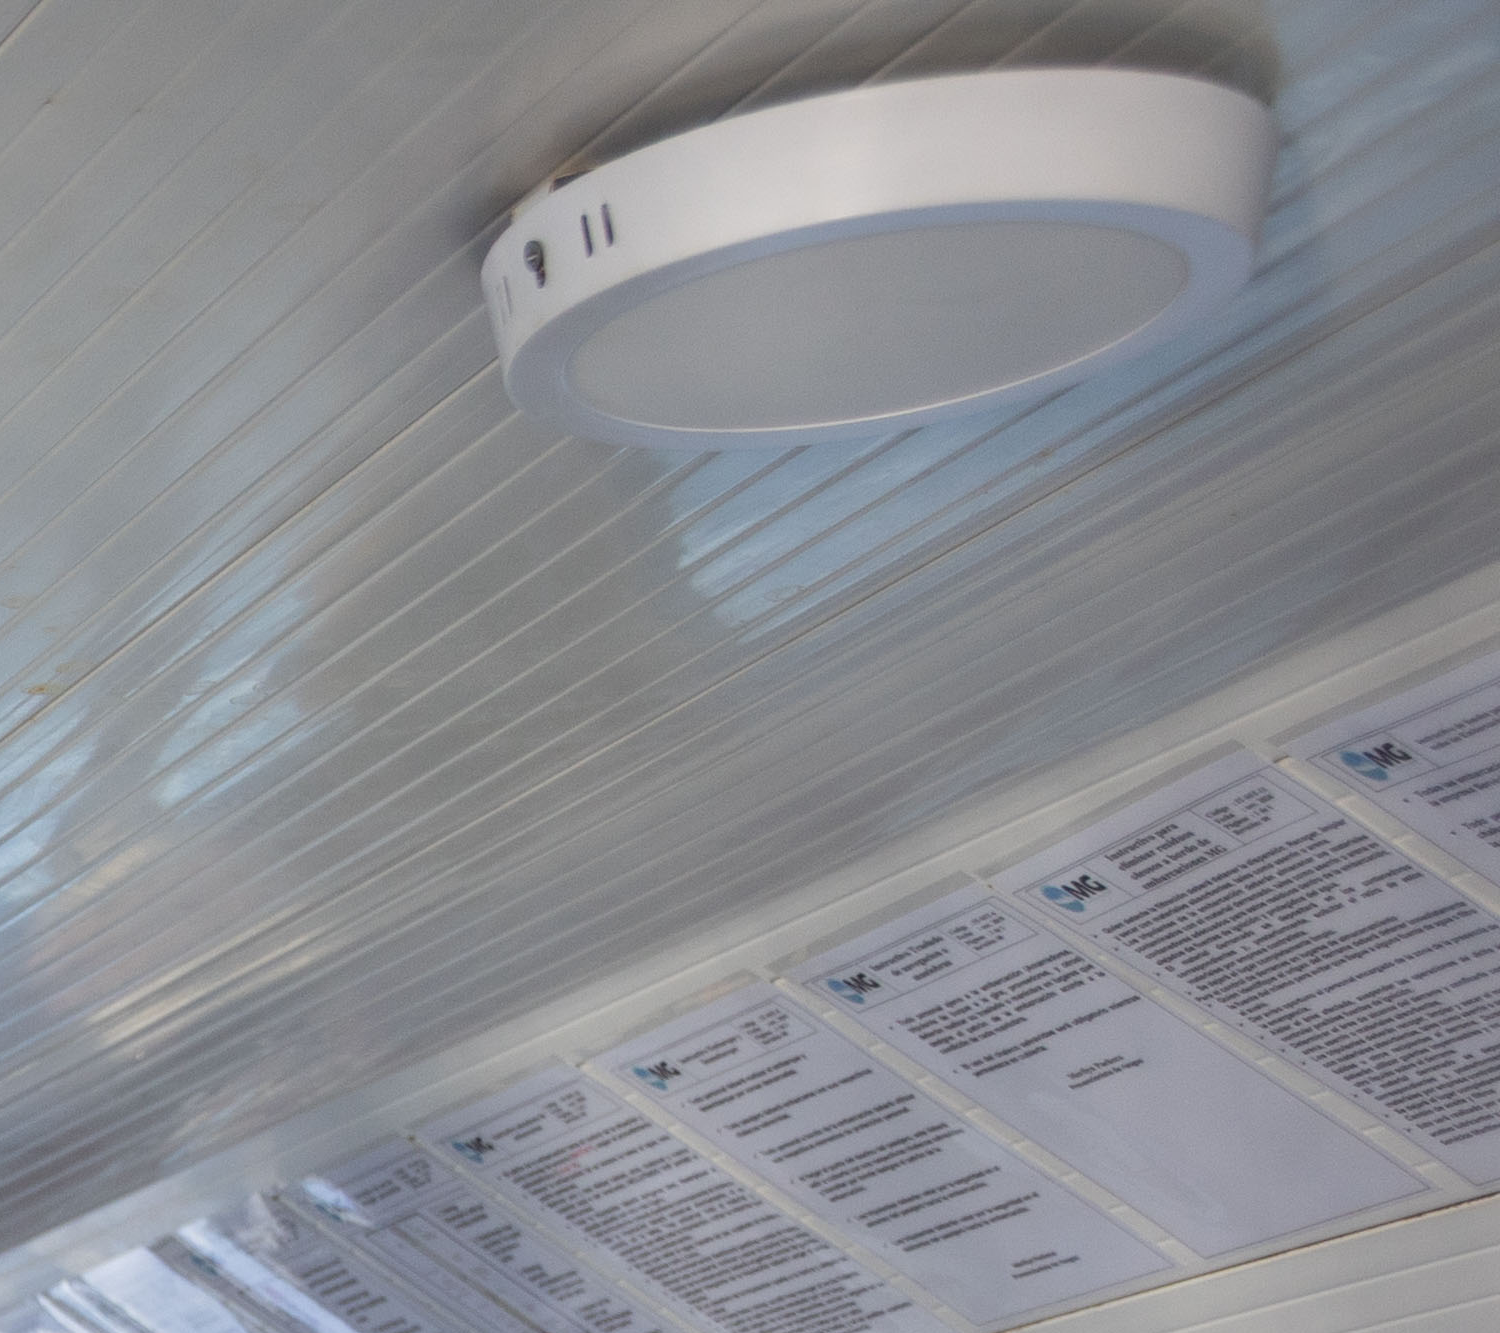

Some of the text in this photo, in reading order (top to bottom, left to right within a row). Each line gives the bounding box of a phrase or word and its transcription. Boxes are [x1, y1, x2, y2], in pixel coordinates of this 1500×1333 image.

[1363, 742, 1412, 769] MG
[1061, 874, 1106, 901] MG
[842, 973, 881, 994] MG
